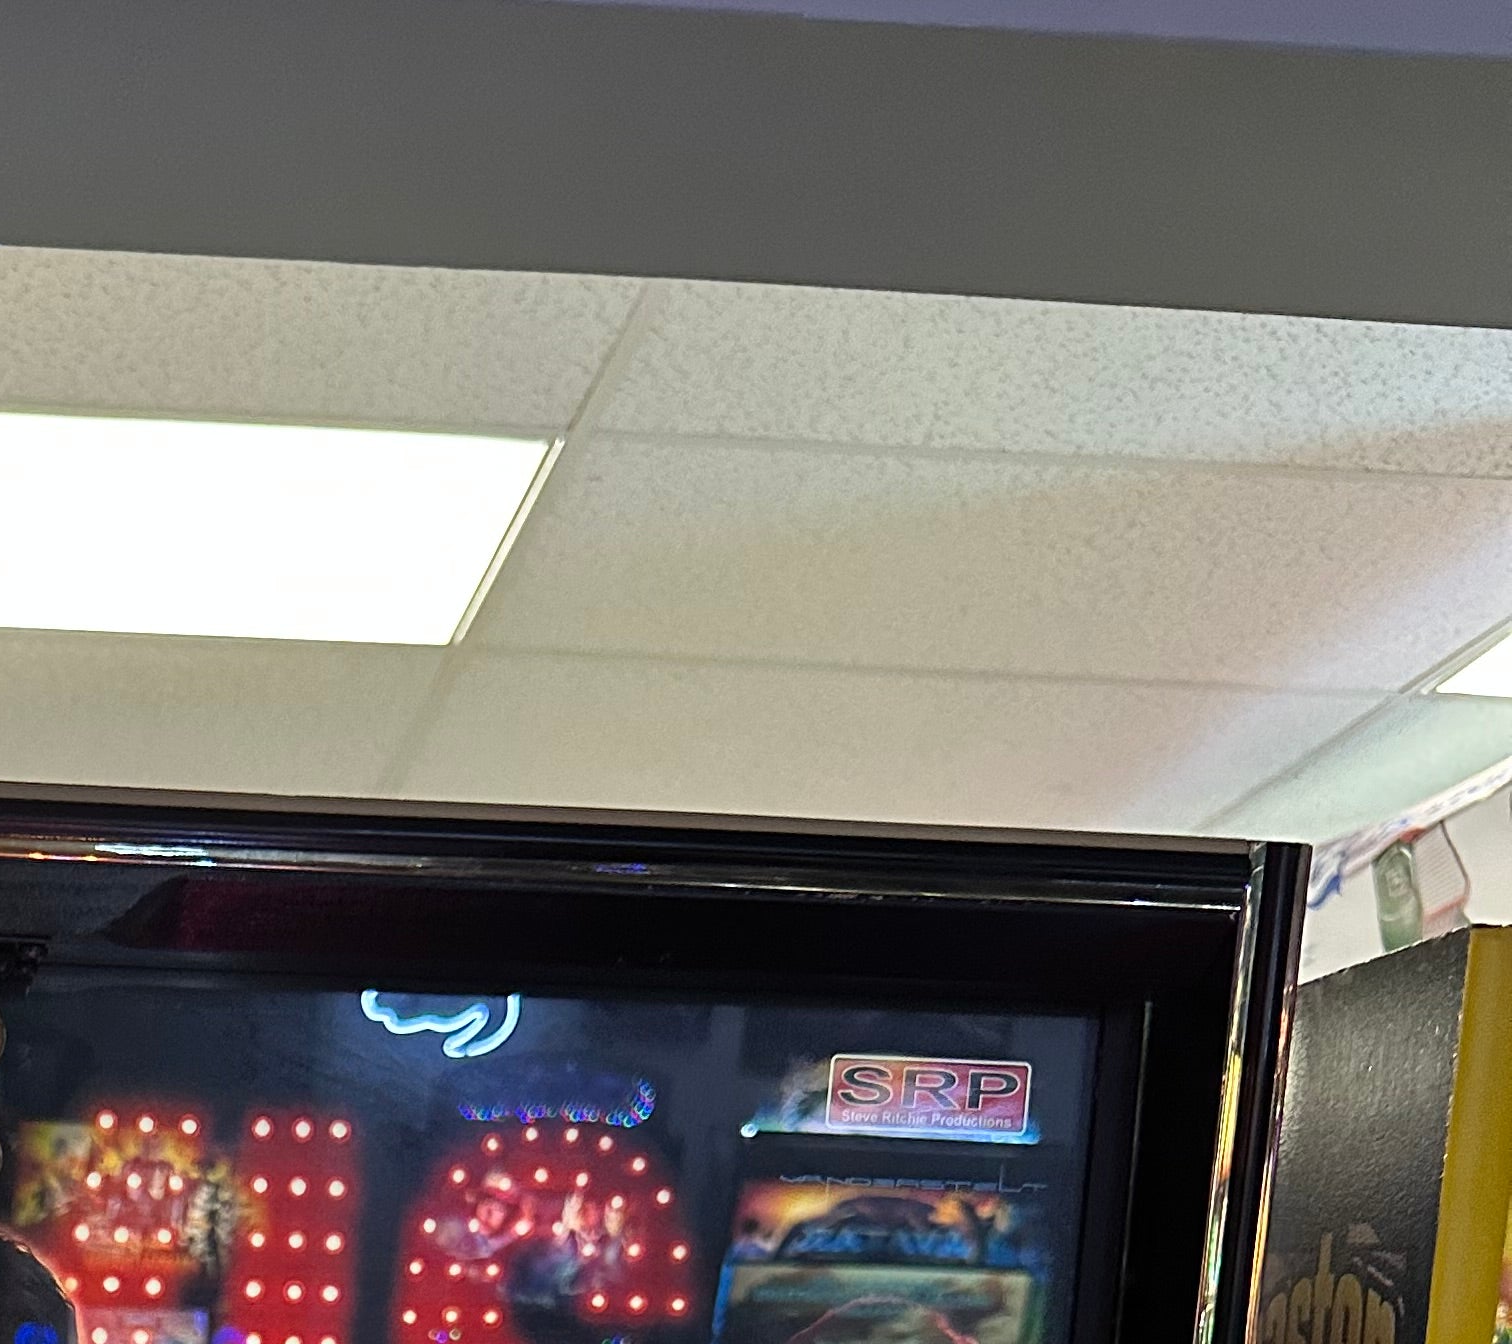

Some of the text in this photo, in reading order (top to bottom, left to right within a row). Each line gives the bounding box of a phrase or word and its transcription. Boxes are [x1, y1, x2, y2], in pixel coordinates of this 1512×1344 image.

[838, 1063, 1022, 1112] SRP
[841, 1109, 1012, 1128] Steve Ritchie Productions
